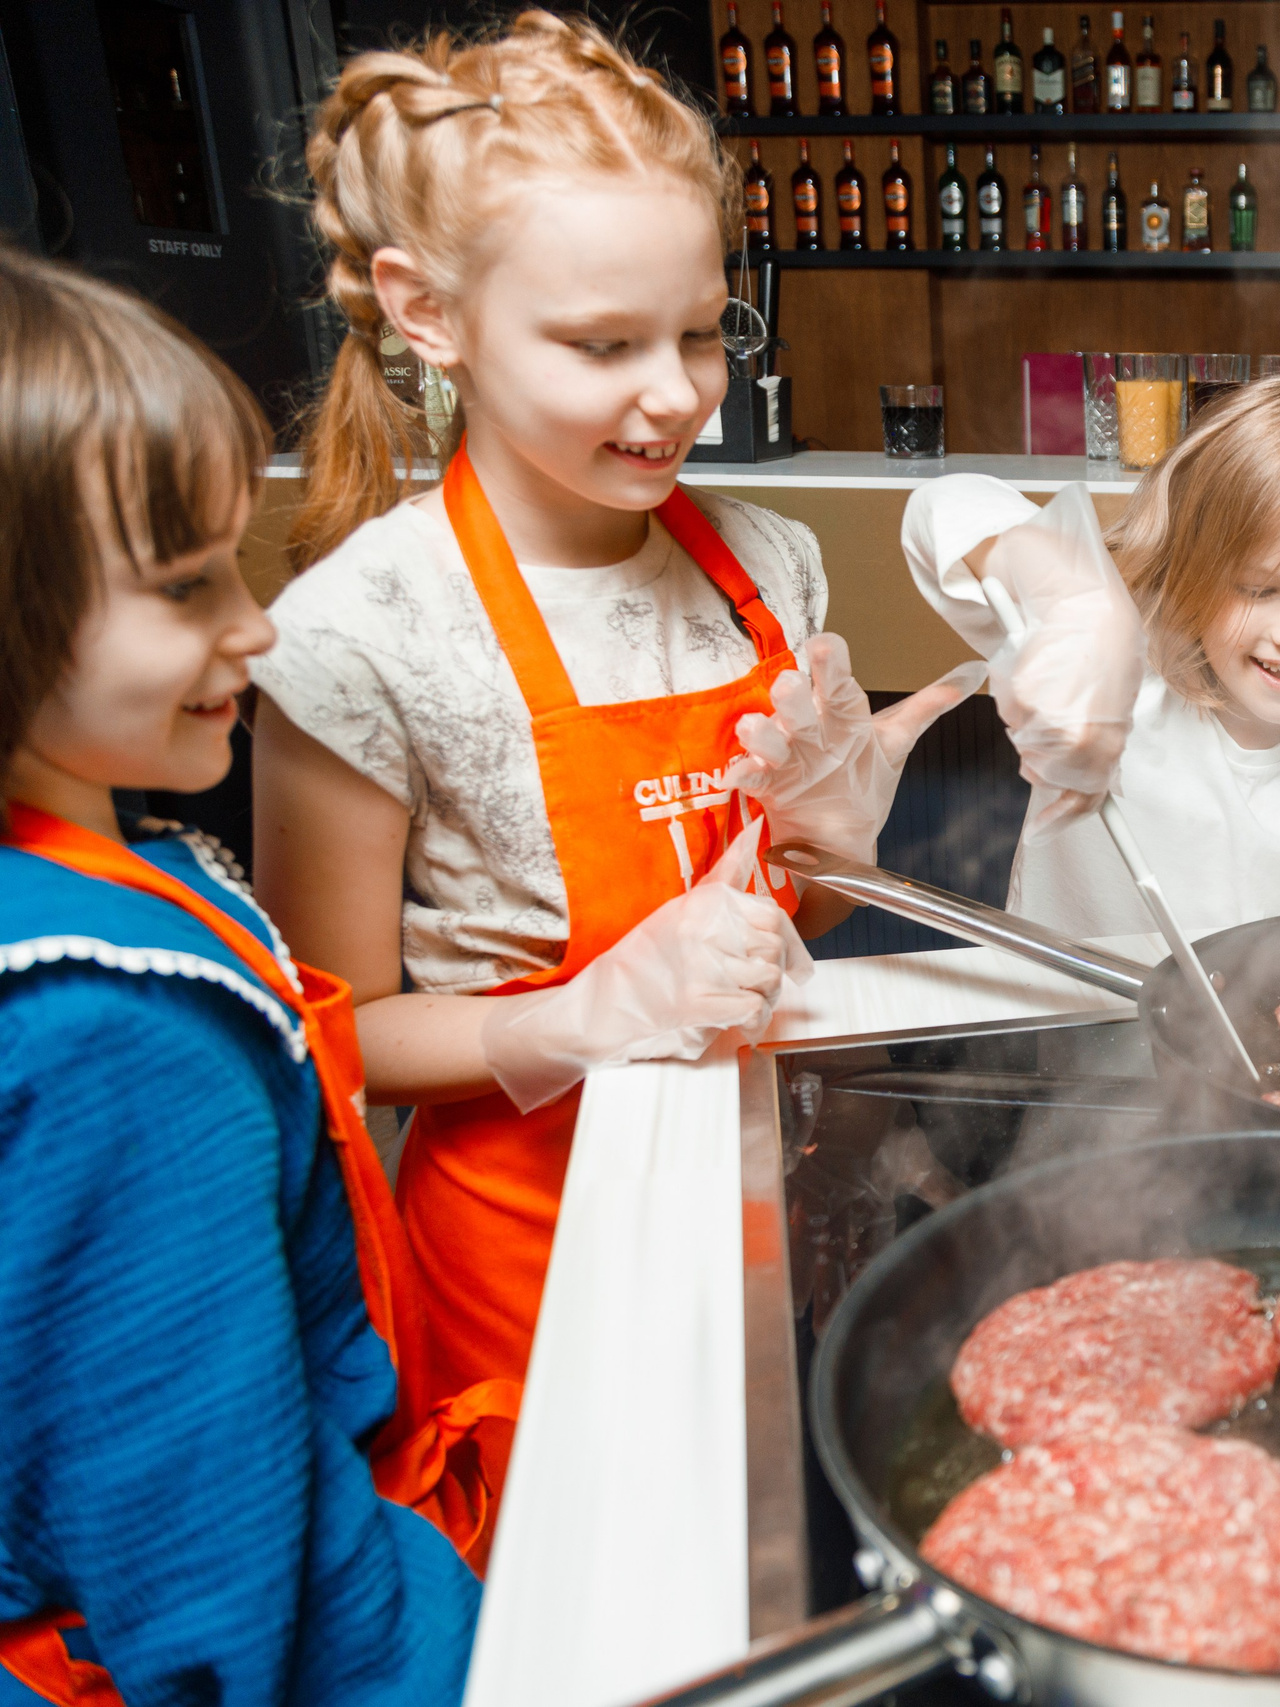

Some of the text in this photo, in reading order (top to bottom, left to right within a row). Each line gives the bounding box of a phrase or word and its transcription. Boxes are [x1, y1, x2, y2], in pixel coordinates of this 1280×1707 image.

[149, 239, 223, 258] STAFF ONLY
[383, 366, 412, 377] ASSIC
[633, 760, 735, 806] CULIN
